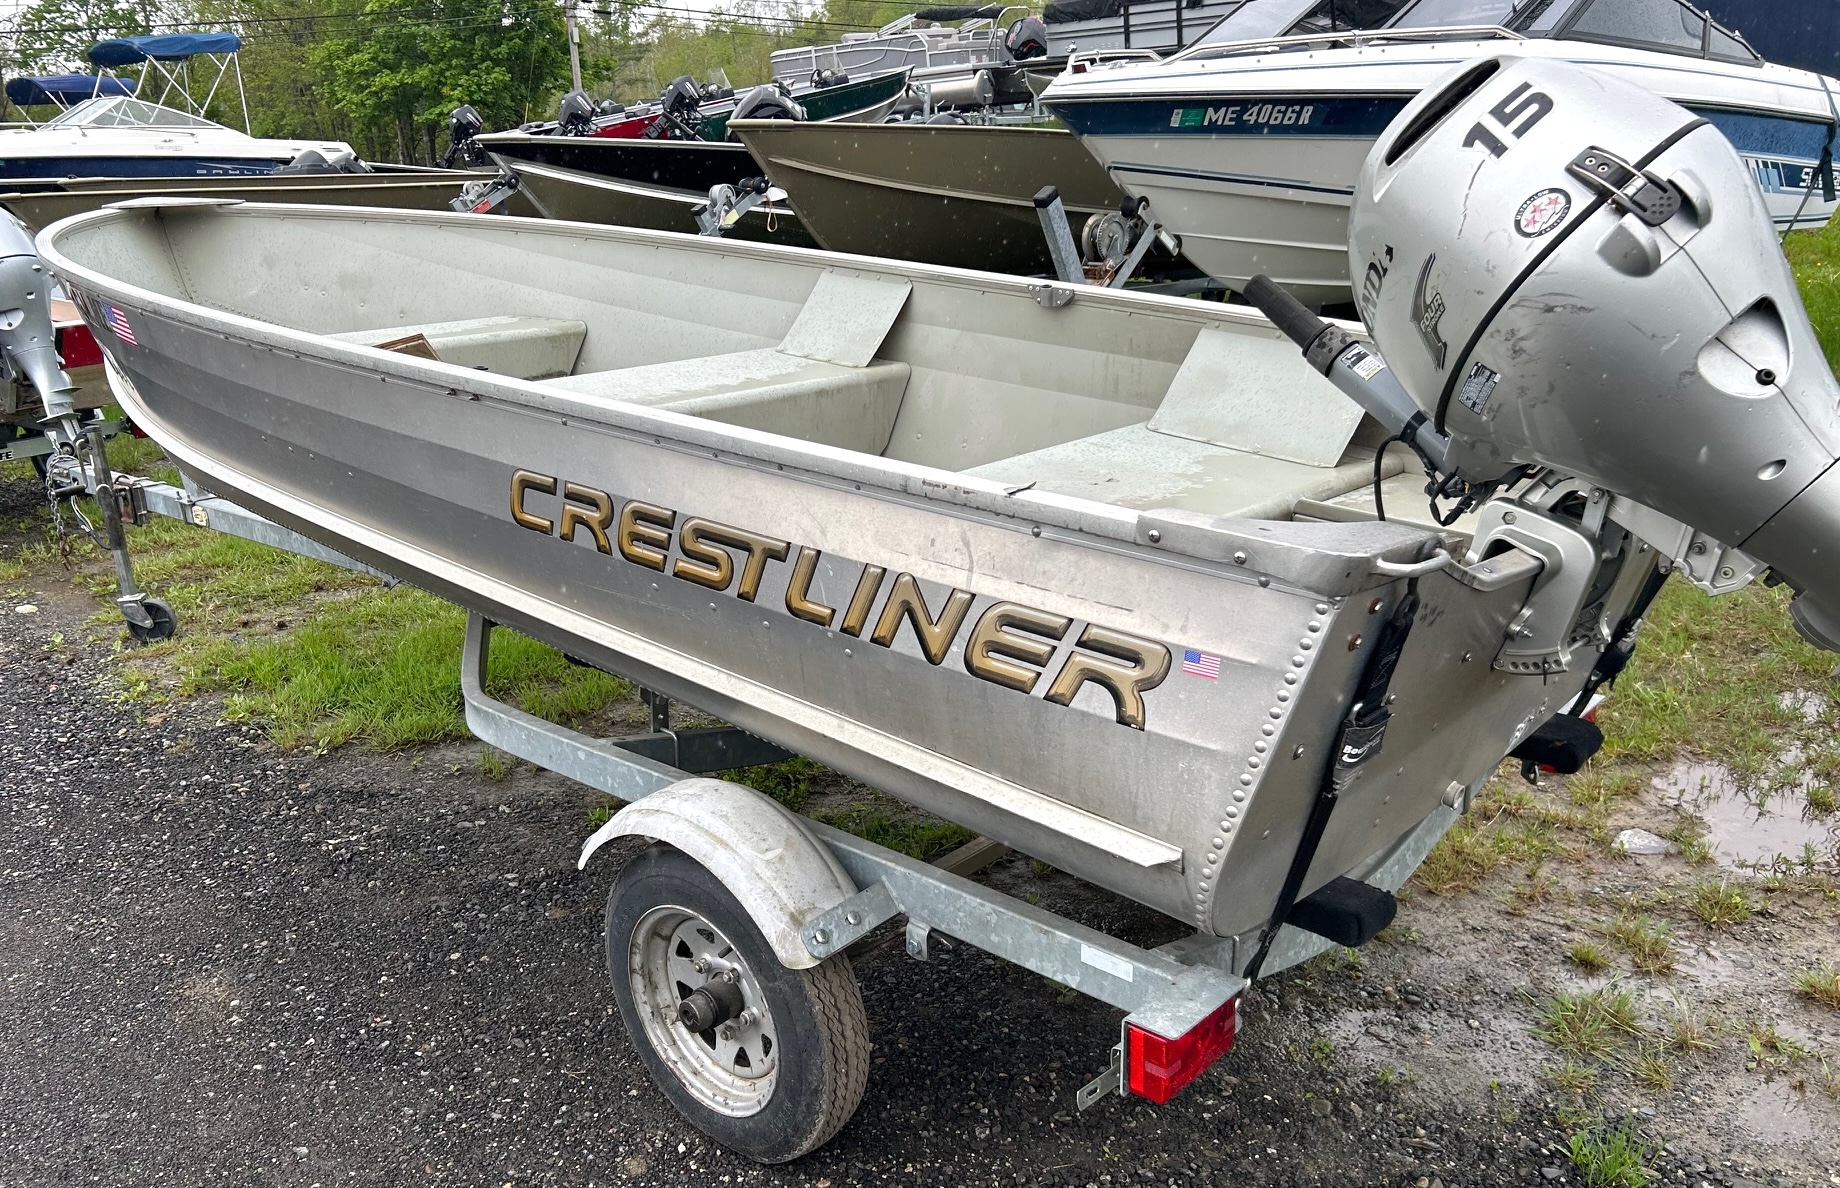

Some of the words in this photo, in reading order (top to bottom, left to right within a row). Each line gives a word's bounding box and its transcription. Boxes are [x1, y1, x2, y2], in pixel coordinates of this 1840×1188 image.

[1203, 106, 1241, 126] ME
[1242, 103, 1314, 125] 4066R
[1462, 81, 1554, 159] 15
[1420, 294, 1443, 333] FOUR
[1427, 303, 1445, 334] STROKE
[510, 468, 1173, 732] CRESTLINER
